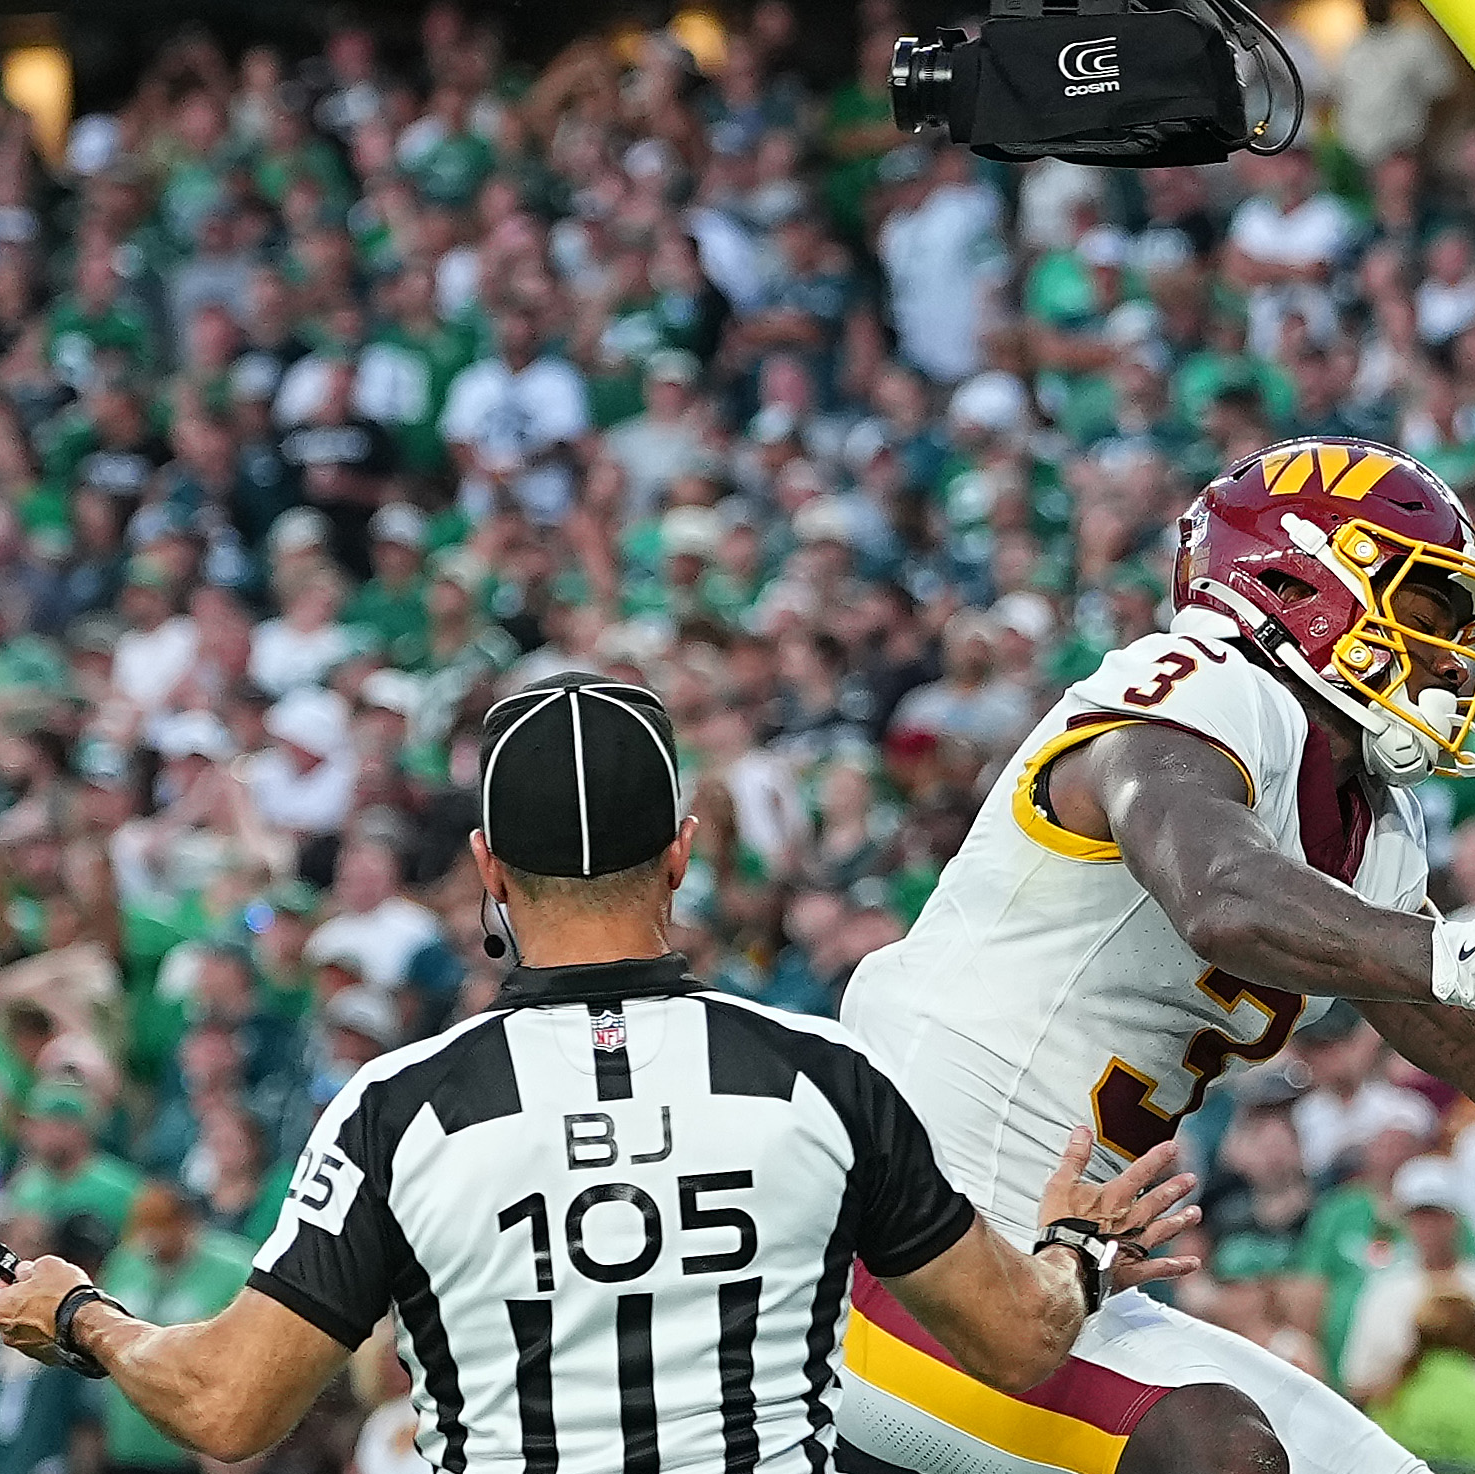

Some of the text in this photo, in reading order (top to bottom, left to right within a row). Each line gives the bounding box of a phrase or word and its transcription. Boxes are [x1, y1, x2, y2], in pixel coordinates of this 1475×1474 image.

[1064, 81, 1120, 97] cosm
[1123, 652, 1198, 710] 3
[595, 1028, 626, 1045] NFL
[1090, 966, 1307, 1162] 3
[563, 1105, 673, 1171] BJ
[497, 1169, 758, 1292] 105
